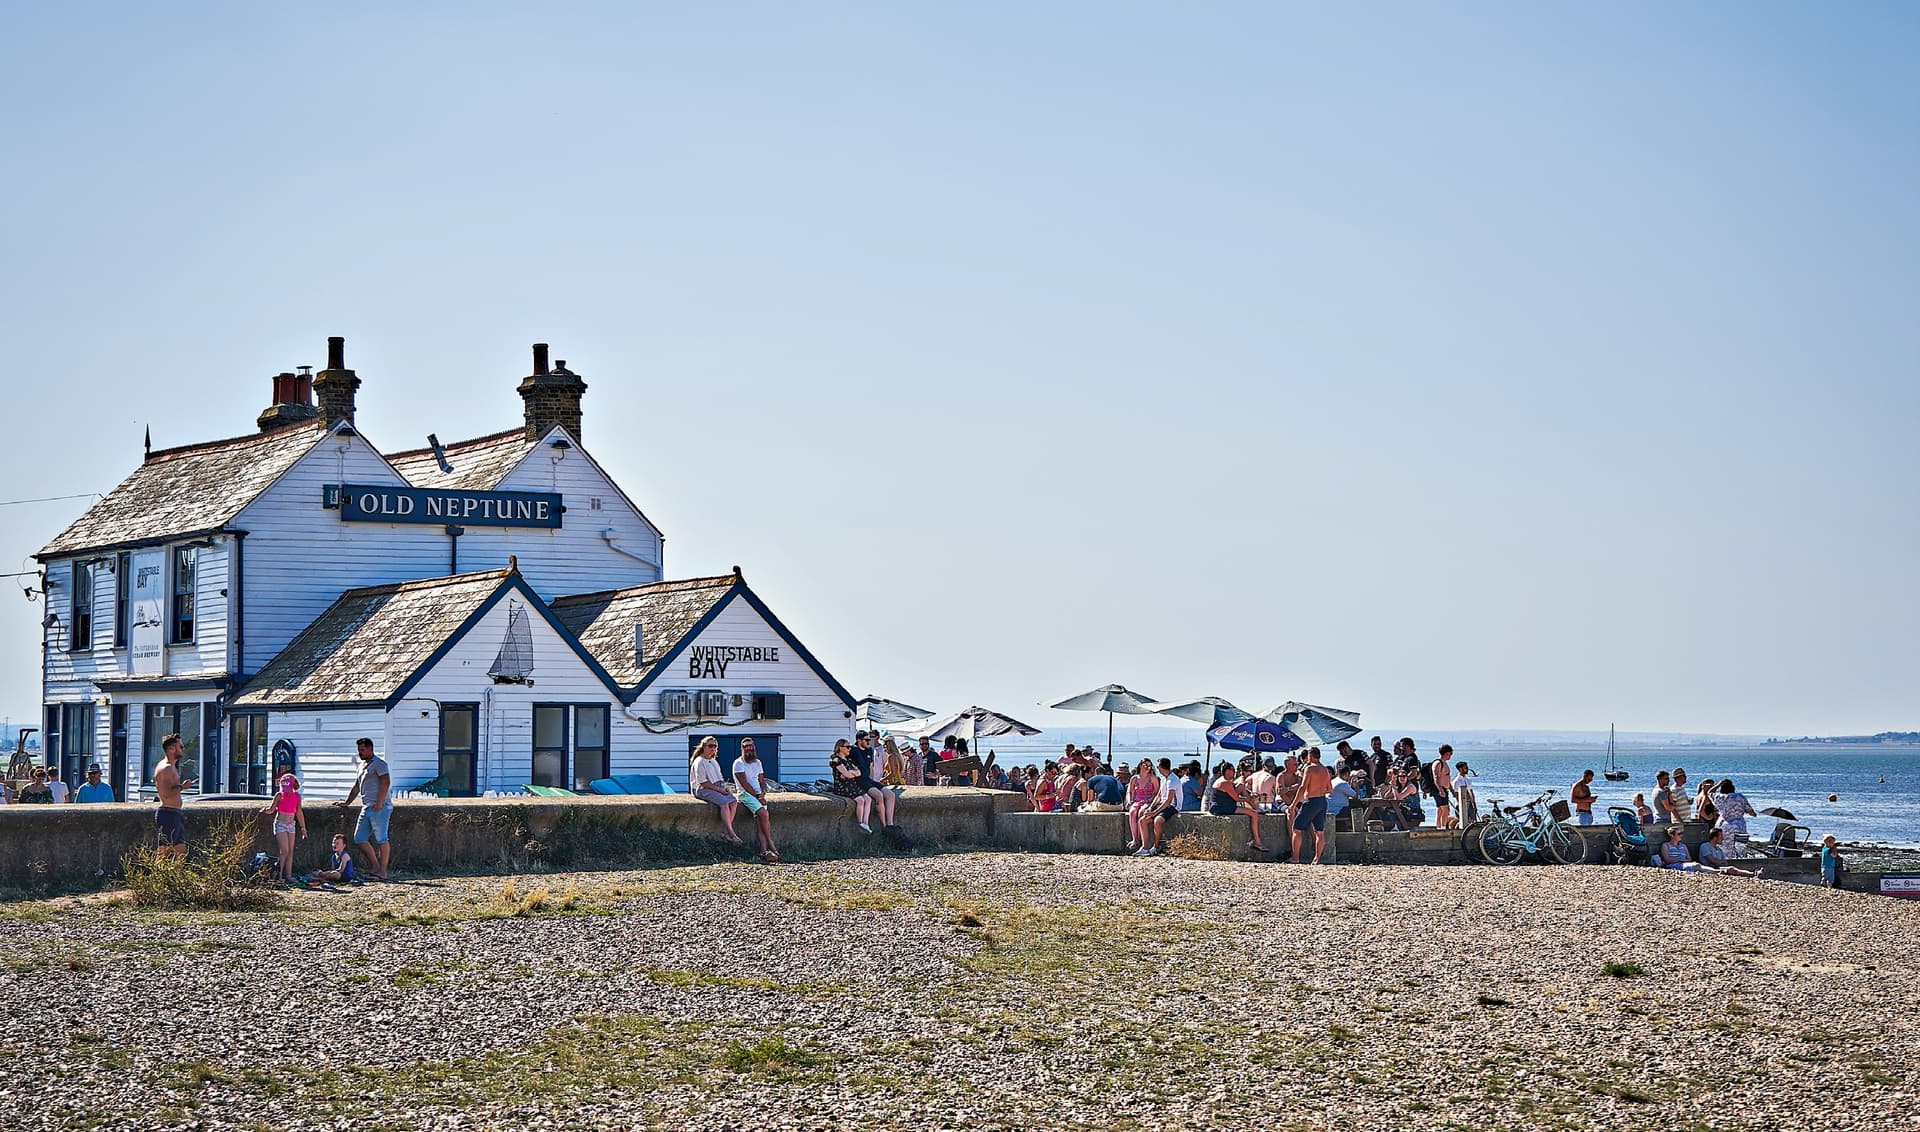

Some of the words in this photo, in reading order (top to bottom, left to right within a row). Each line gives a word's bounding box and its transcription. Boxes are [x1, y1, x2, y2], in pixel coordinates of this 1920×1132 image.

[359, 493, 414, 515] OLD
[426, 496, 549, 520] NEPTUNE
[691, 645, 779, 662] WHITSTABLE
[690, 657, 729, 679] BAY
